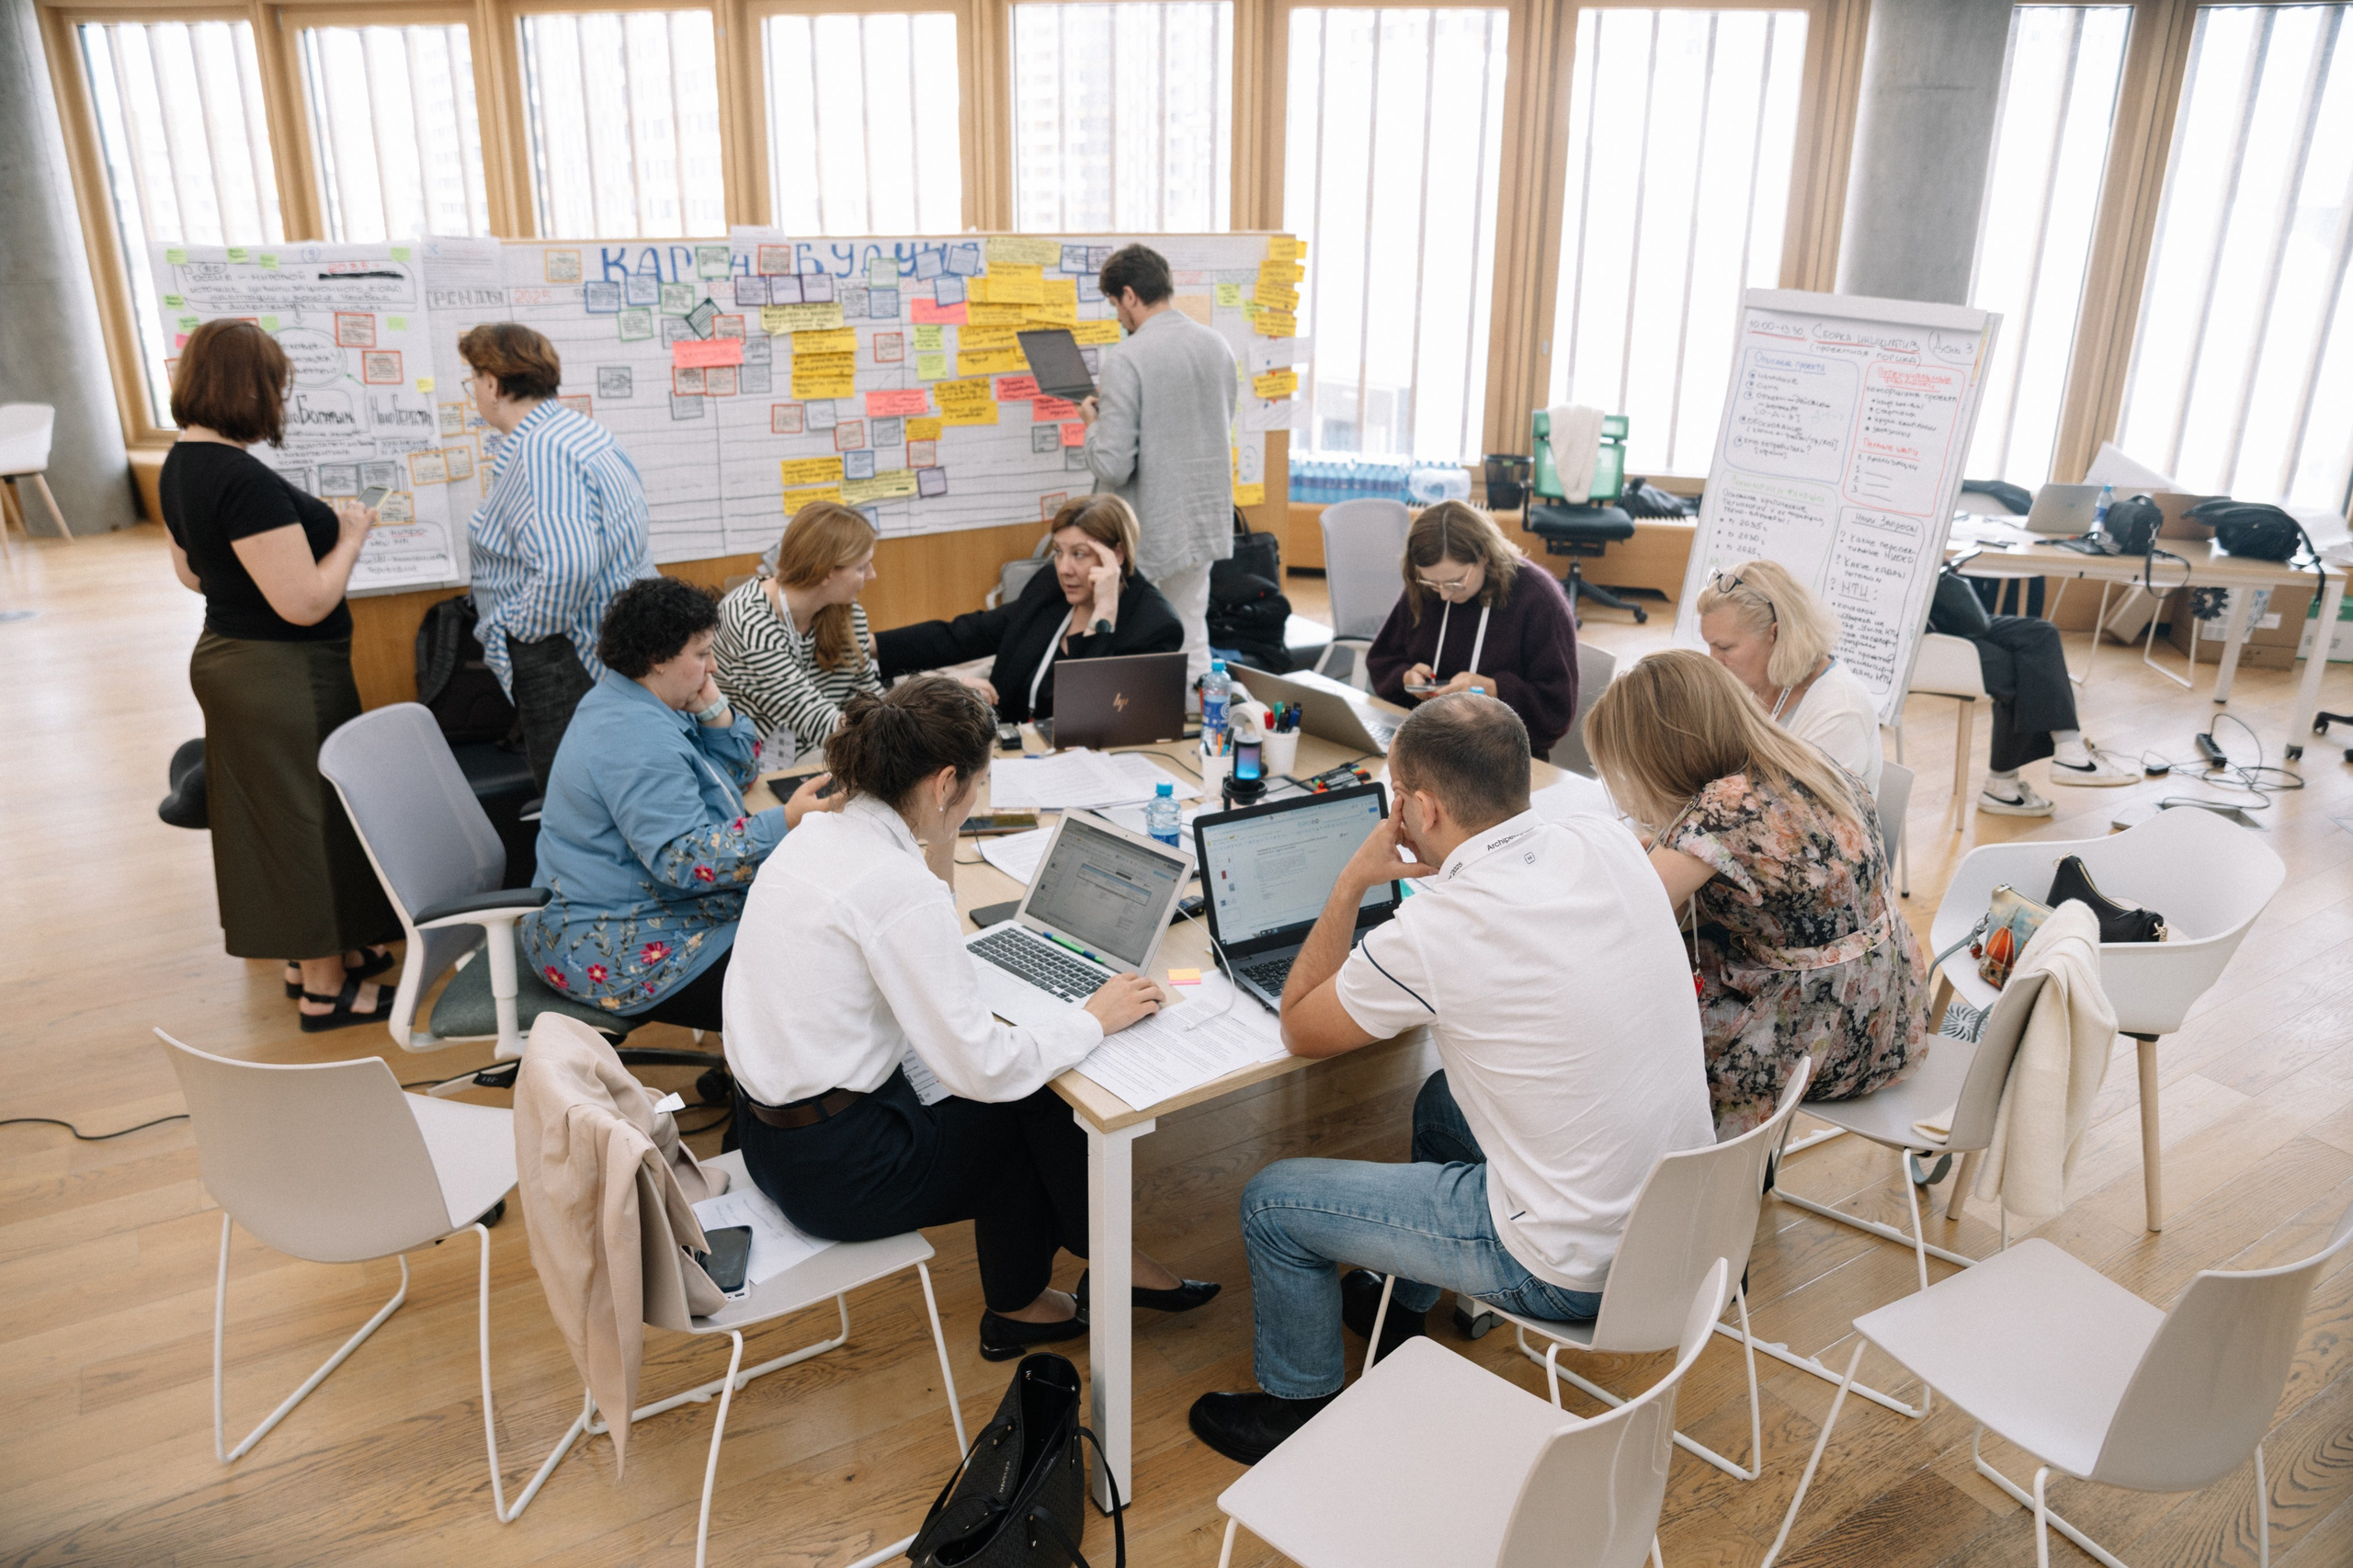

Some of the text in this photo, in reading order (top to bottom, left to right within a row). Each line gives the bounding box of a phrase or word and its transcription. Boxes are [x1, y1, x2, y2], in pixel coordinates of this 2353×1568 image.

[1739, 518, 1763, 530] 2035
[1738, 531, 1759, 542] 2030
[1736, 544, 1756, 555] 2025
[1113, 692, 1130, 712] hp
